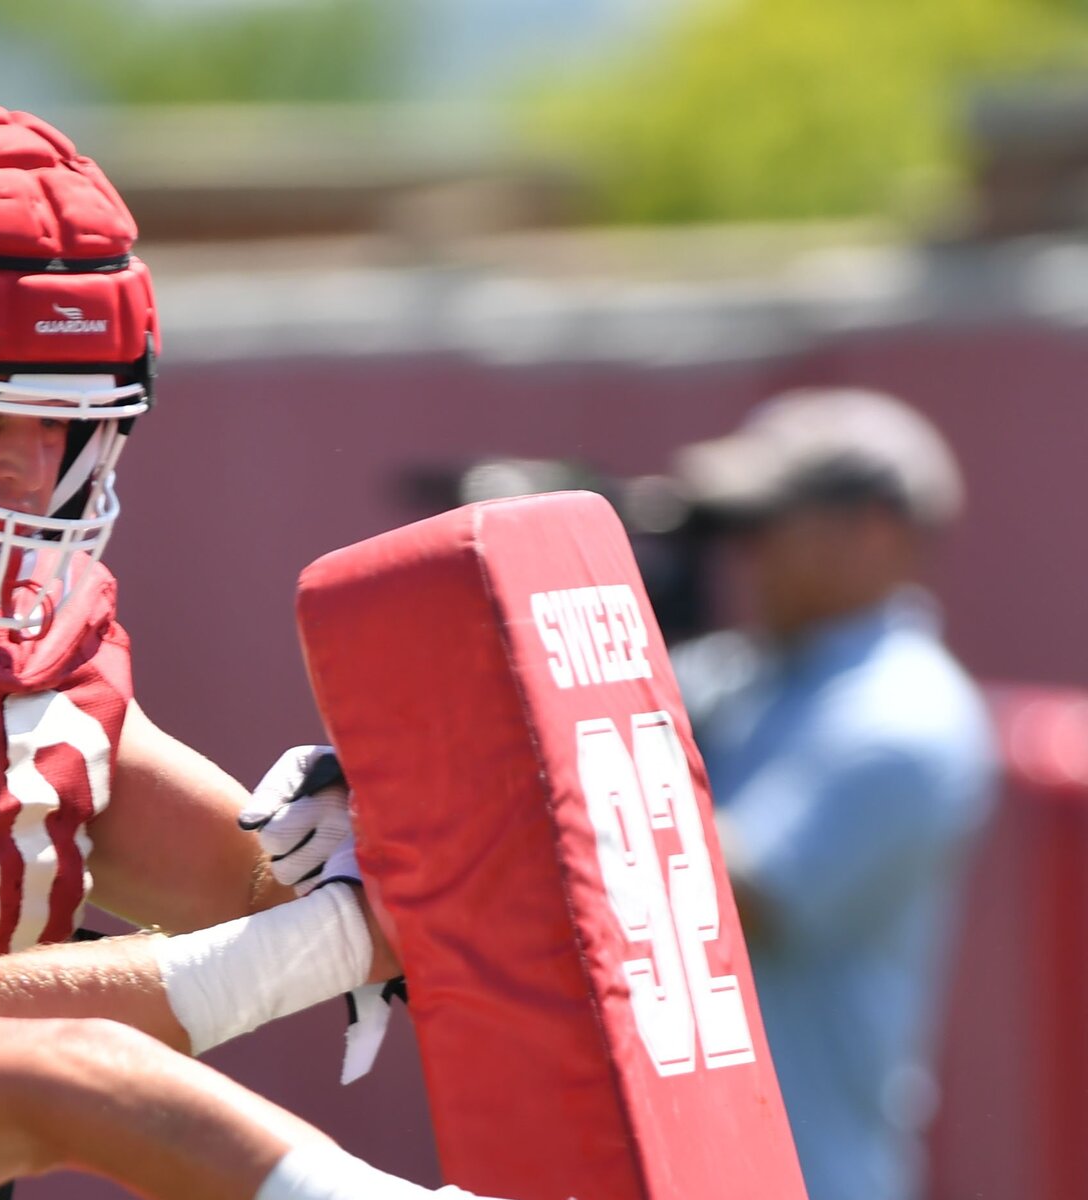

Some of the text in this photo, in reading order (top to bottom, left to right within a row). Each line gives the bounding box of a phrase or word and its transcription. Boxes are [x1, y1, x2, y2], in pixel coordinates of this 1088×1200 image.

[34, 319, 109, 334] GUARDIAN
[530, 584, 653, 690] SWEEP
[575, 710, 757, 1077] 92
